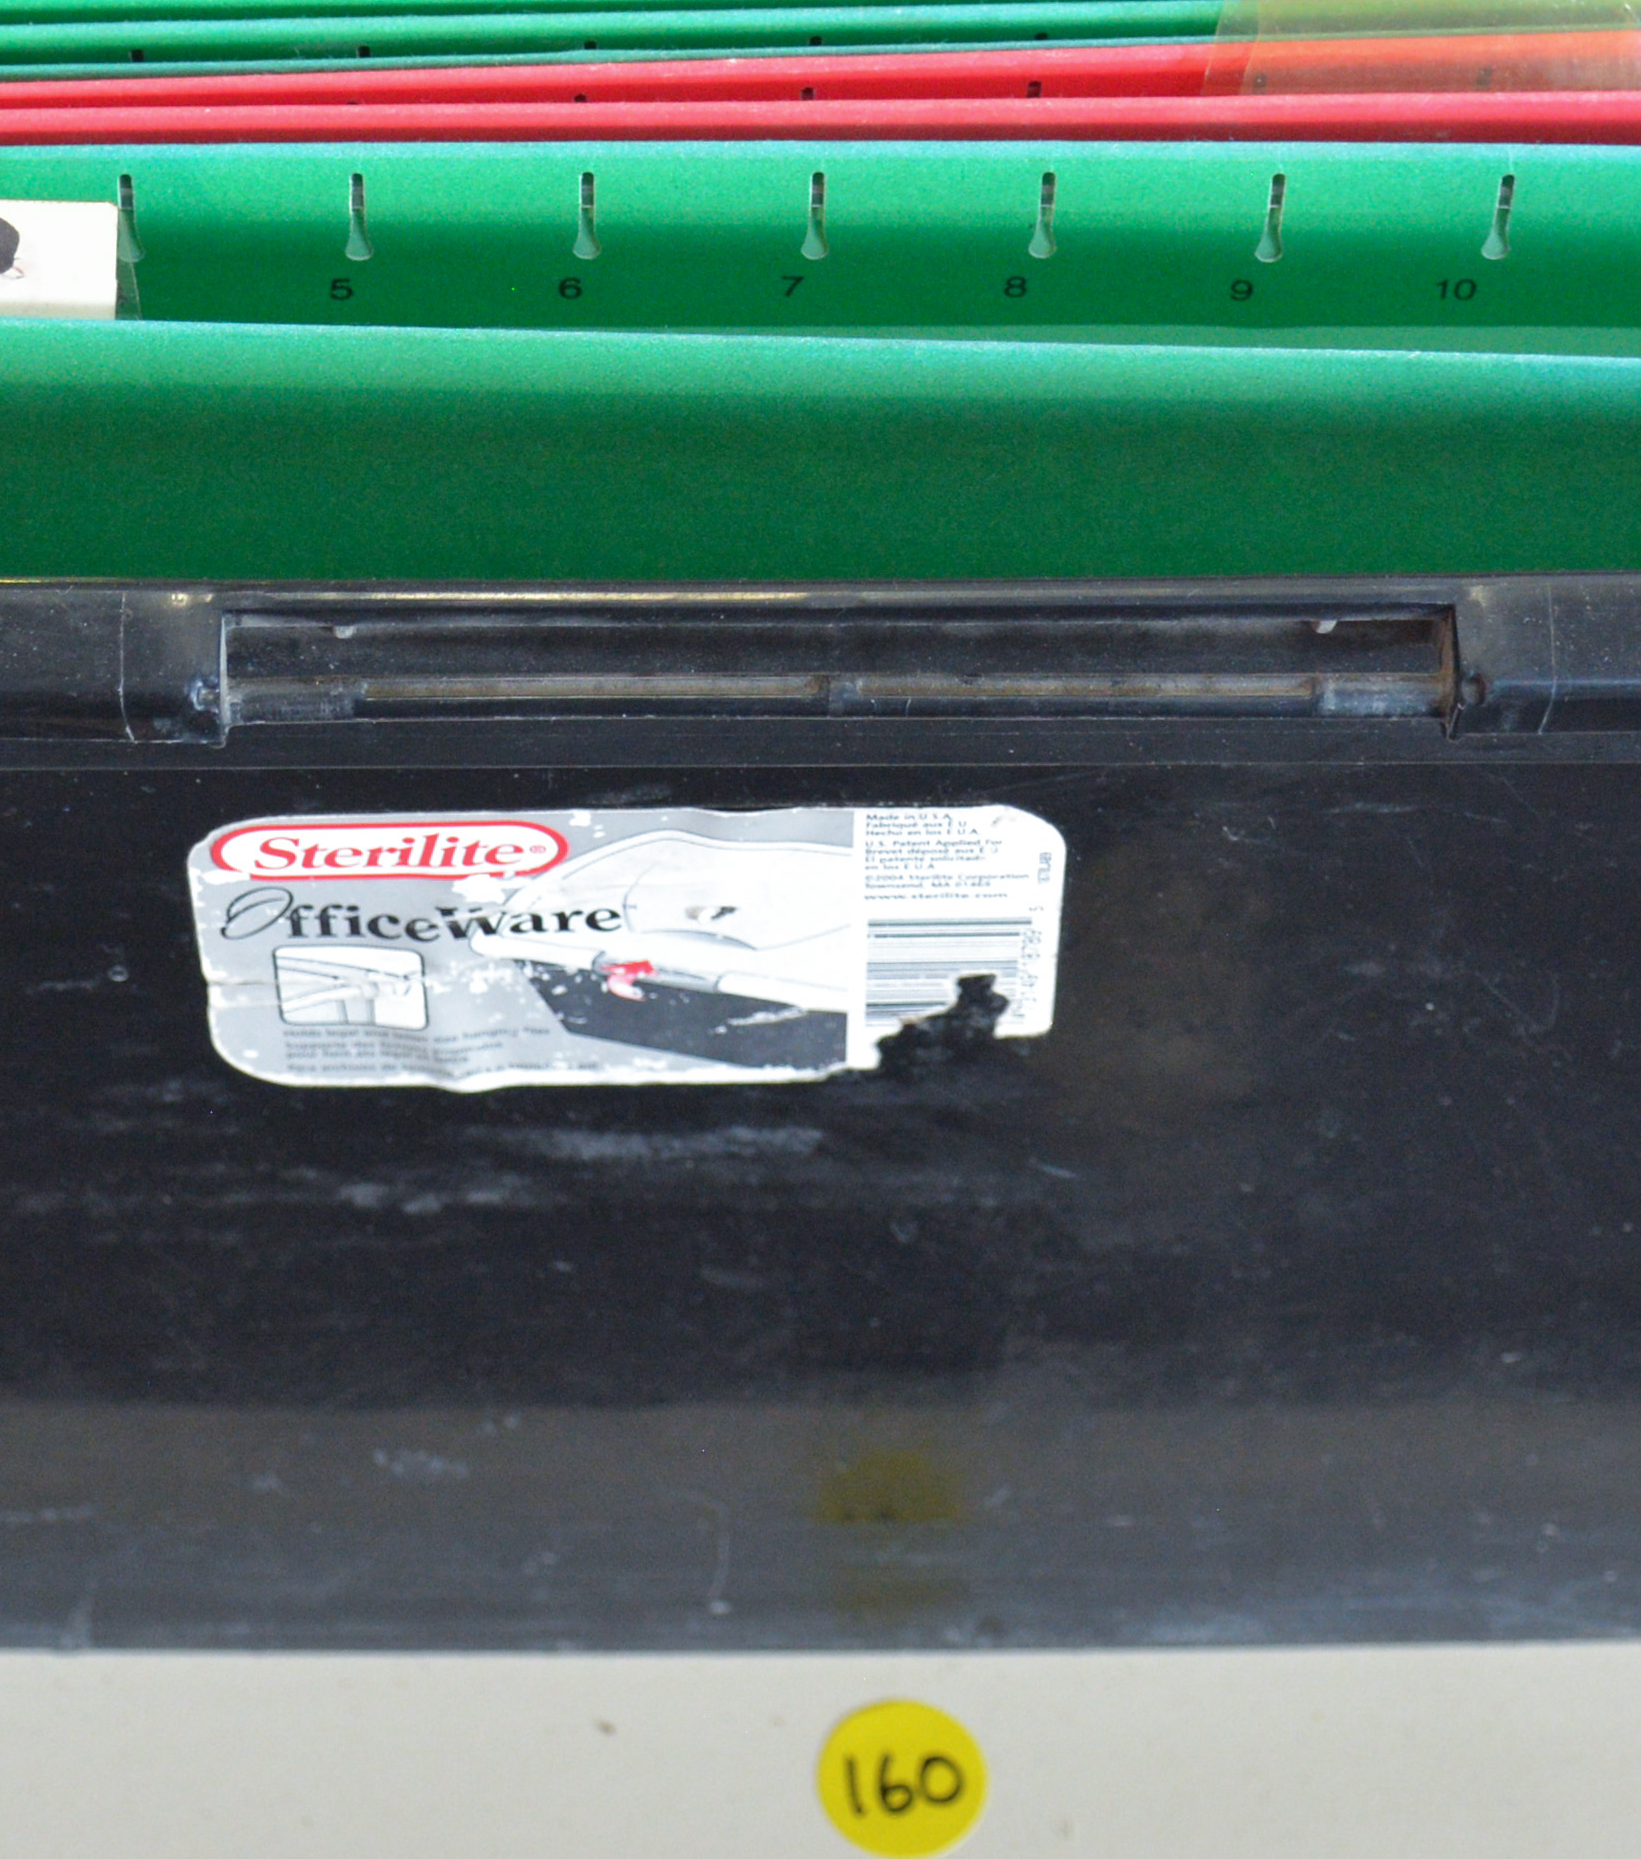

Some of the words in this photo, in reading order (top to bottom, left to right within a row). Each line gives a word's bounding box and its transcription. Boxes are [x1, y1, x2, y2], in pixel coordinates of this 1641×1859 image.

[330, 278, 354, 300] 5
[558, 278, 582, 299] 6
[781, 276, 805, 297] 7
[1004, 276, 1027, 297] 8
[1231, 280, 1253, 301] 9
[1437, 278, 1478, 300] 10
[845, 1753, 965, 1818] 160
